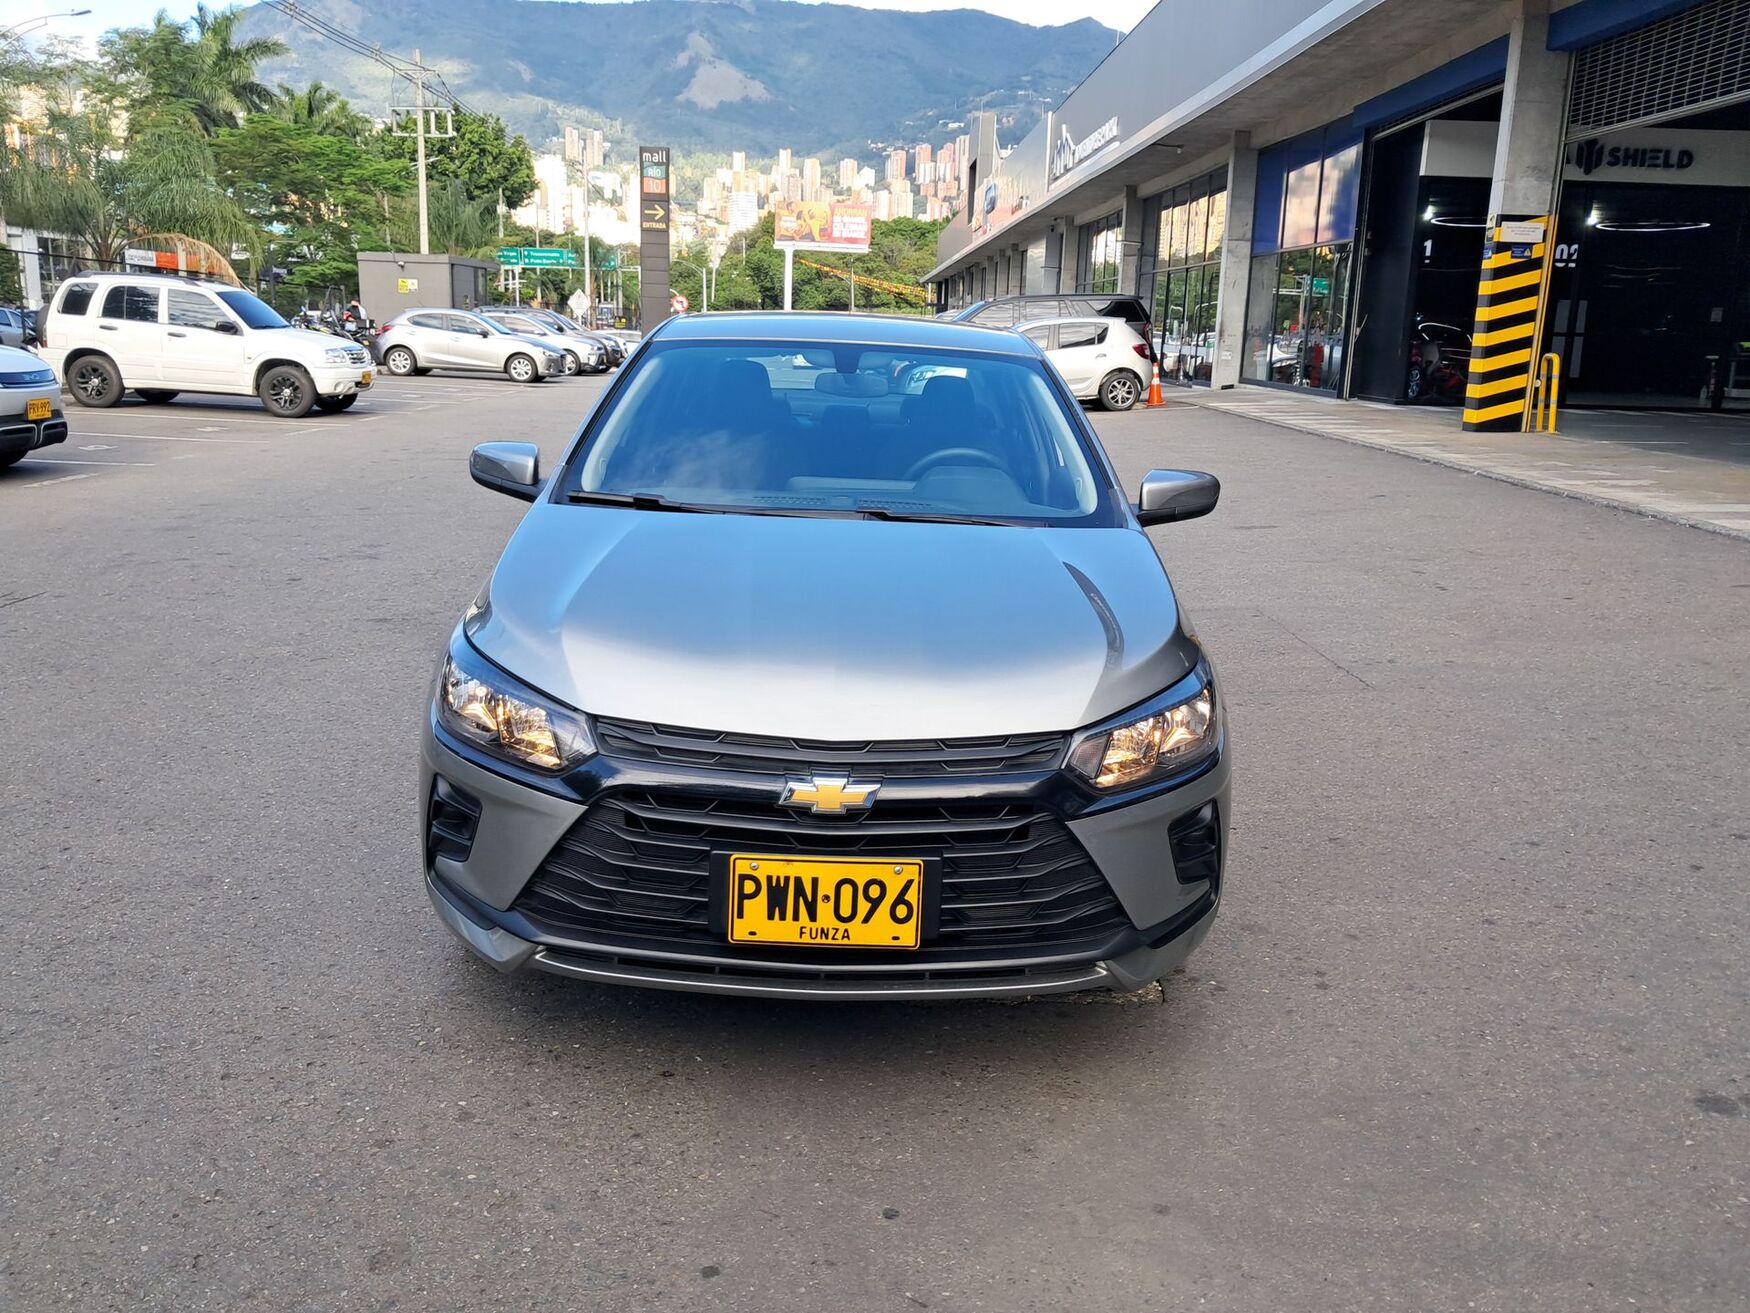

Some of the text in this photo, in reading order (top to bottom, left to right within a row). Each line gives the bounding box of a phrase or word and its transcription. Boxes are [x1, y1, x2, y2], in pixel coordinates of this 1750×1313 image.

[643, 150, 667, 162] mall
[1606, 147, 1694, 168] SHIELD
[649, 180, 662, 193] 10
[1555, 244, 1578, 267] 02
[799, 926, 851, 941] FUNZA
